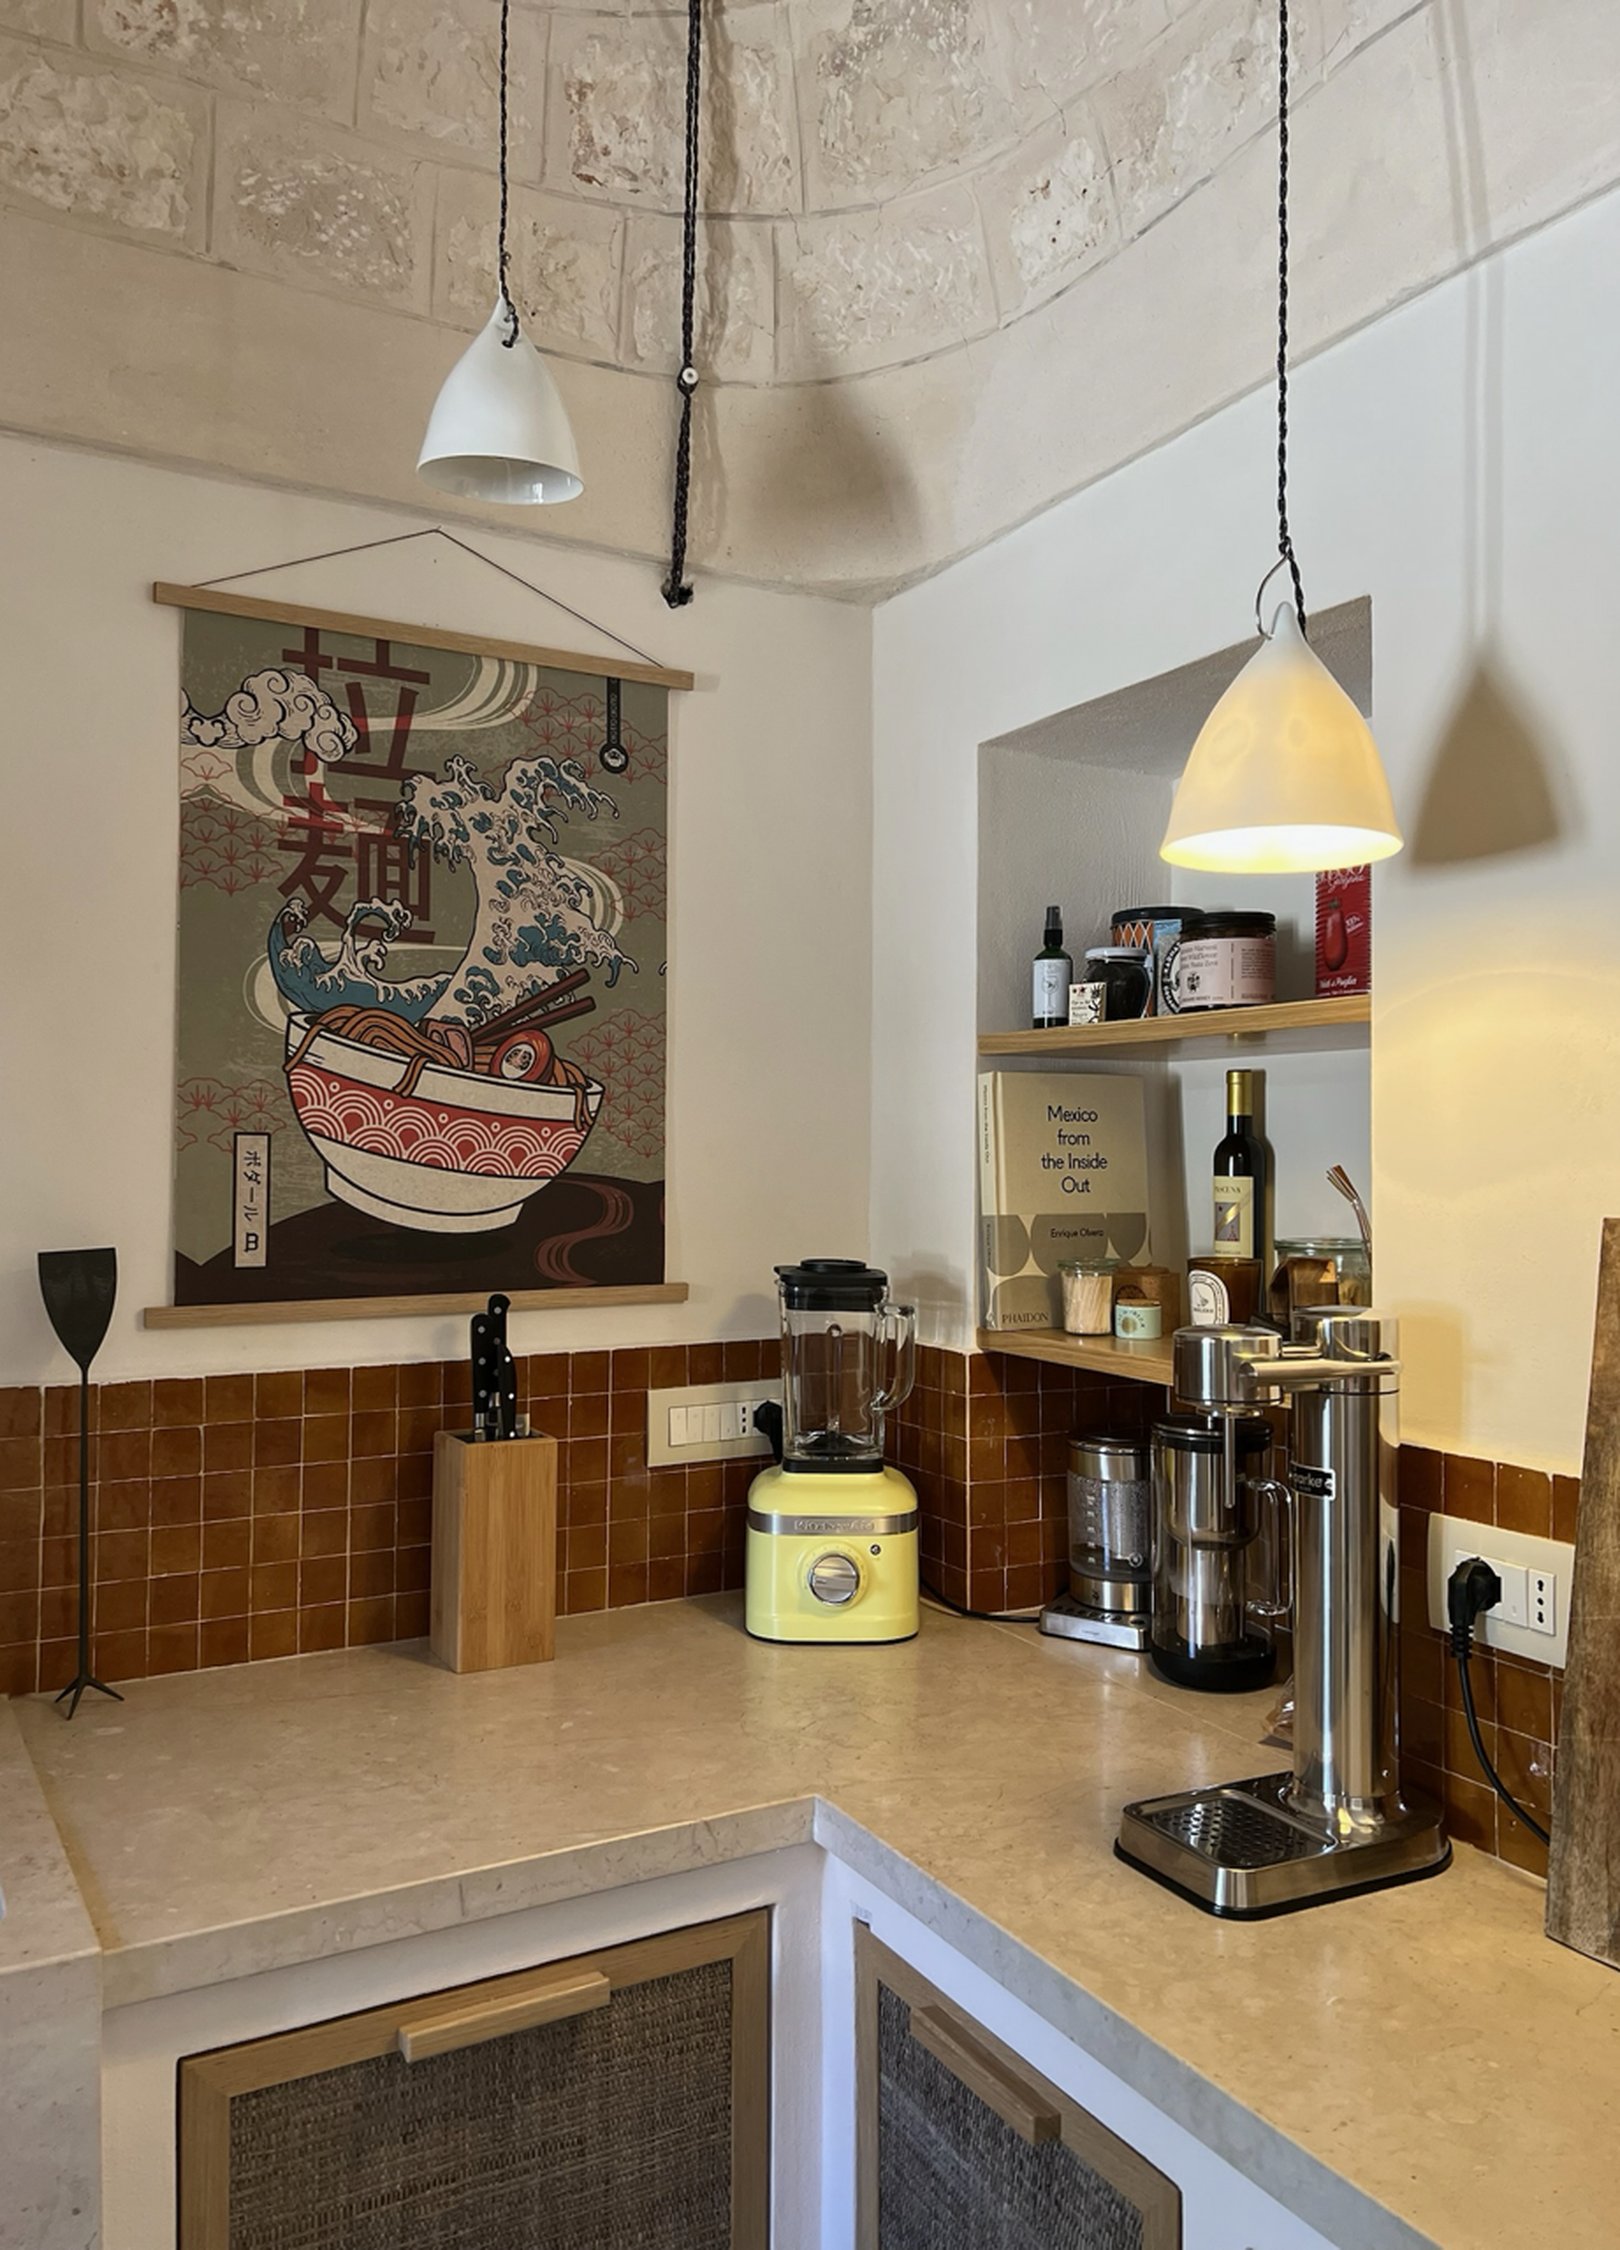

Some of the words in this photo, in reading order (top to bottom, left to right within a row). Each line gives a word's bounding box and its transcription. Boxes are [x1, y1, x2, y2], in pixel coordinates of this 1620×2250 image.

[1047, 1105, 1099, 1122] Mexico
[1057, 1128, 1091, 1146] from
[1041, 1152, 1065, 1170] the
[1067, 1152, 1108, 1170] Inside
[1061, 1175, 1091, 1193] Out
[1050, 1227, 1079, 1239] Enrique
[1002, 1311, 1049, 1324] PHAIDON
